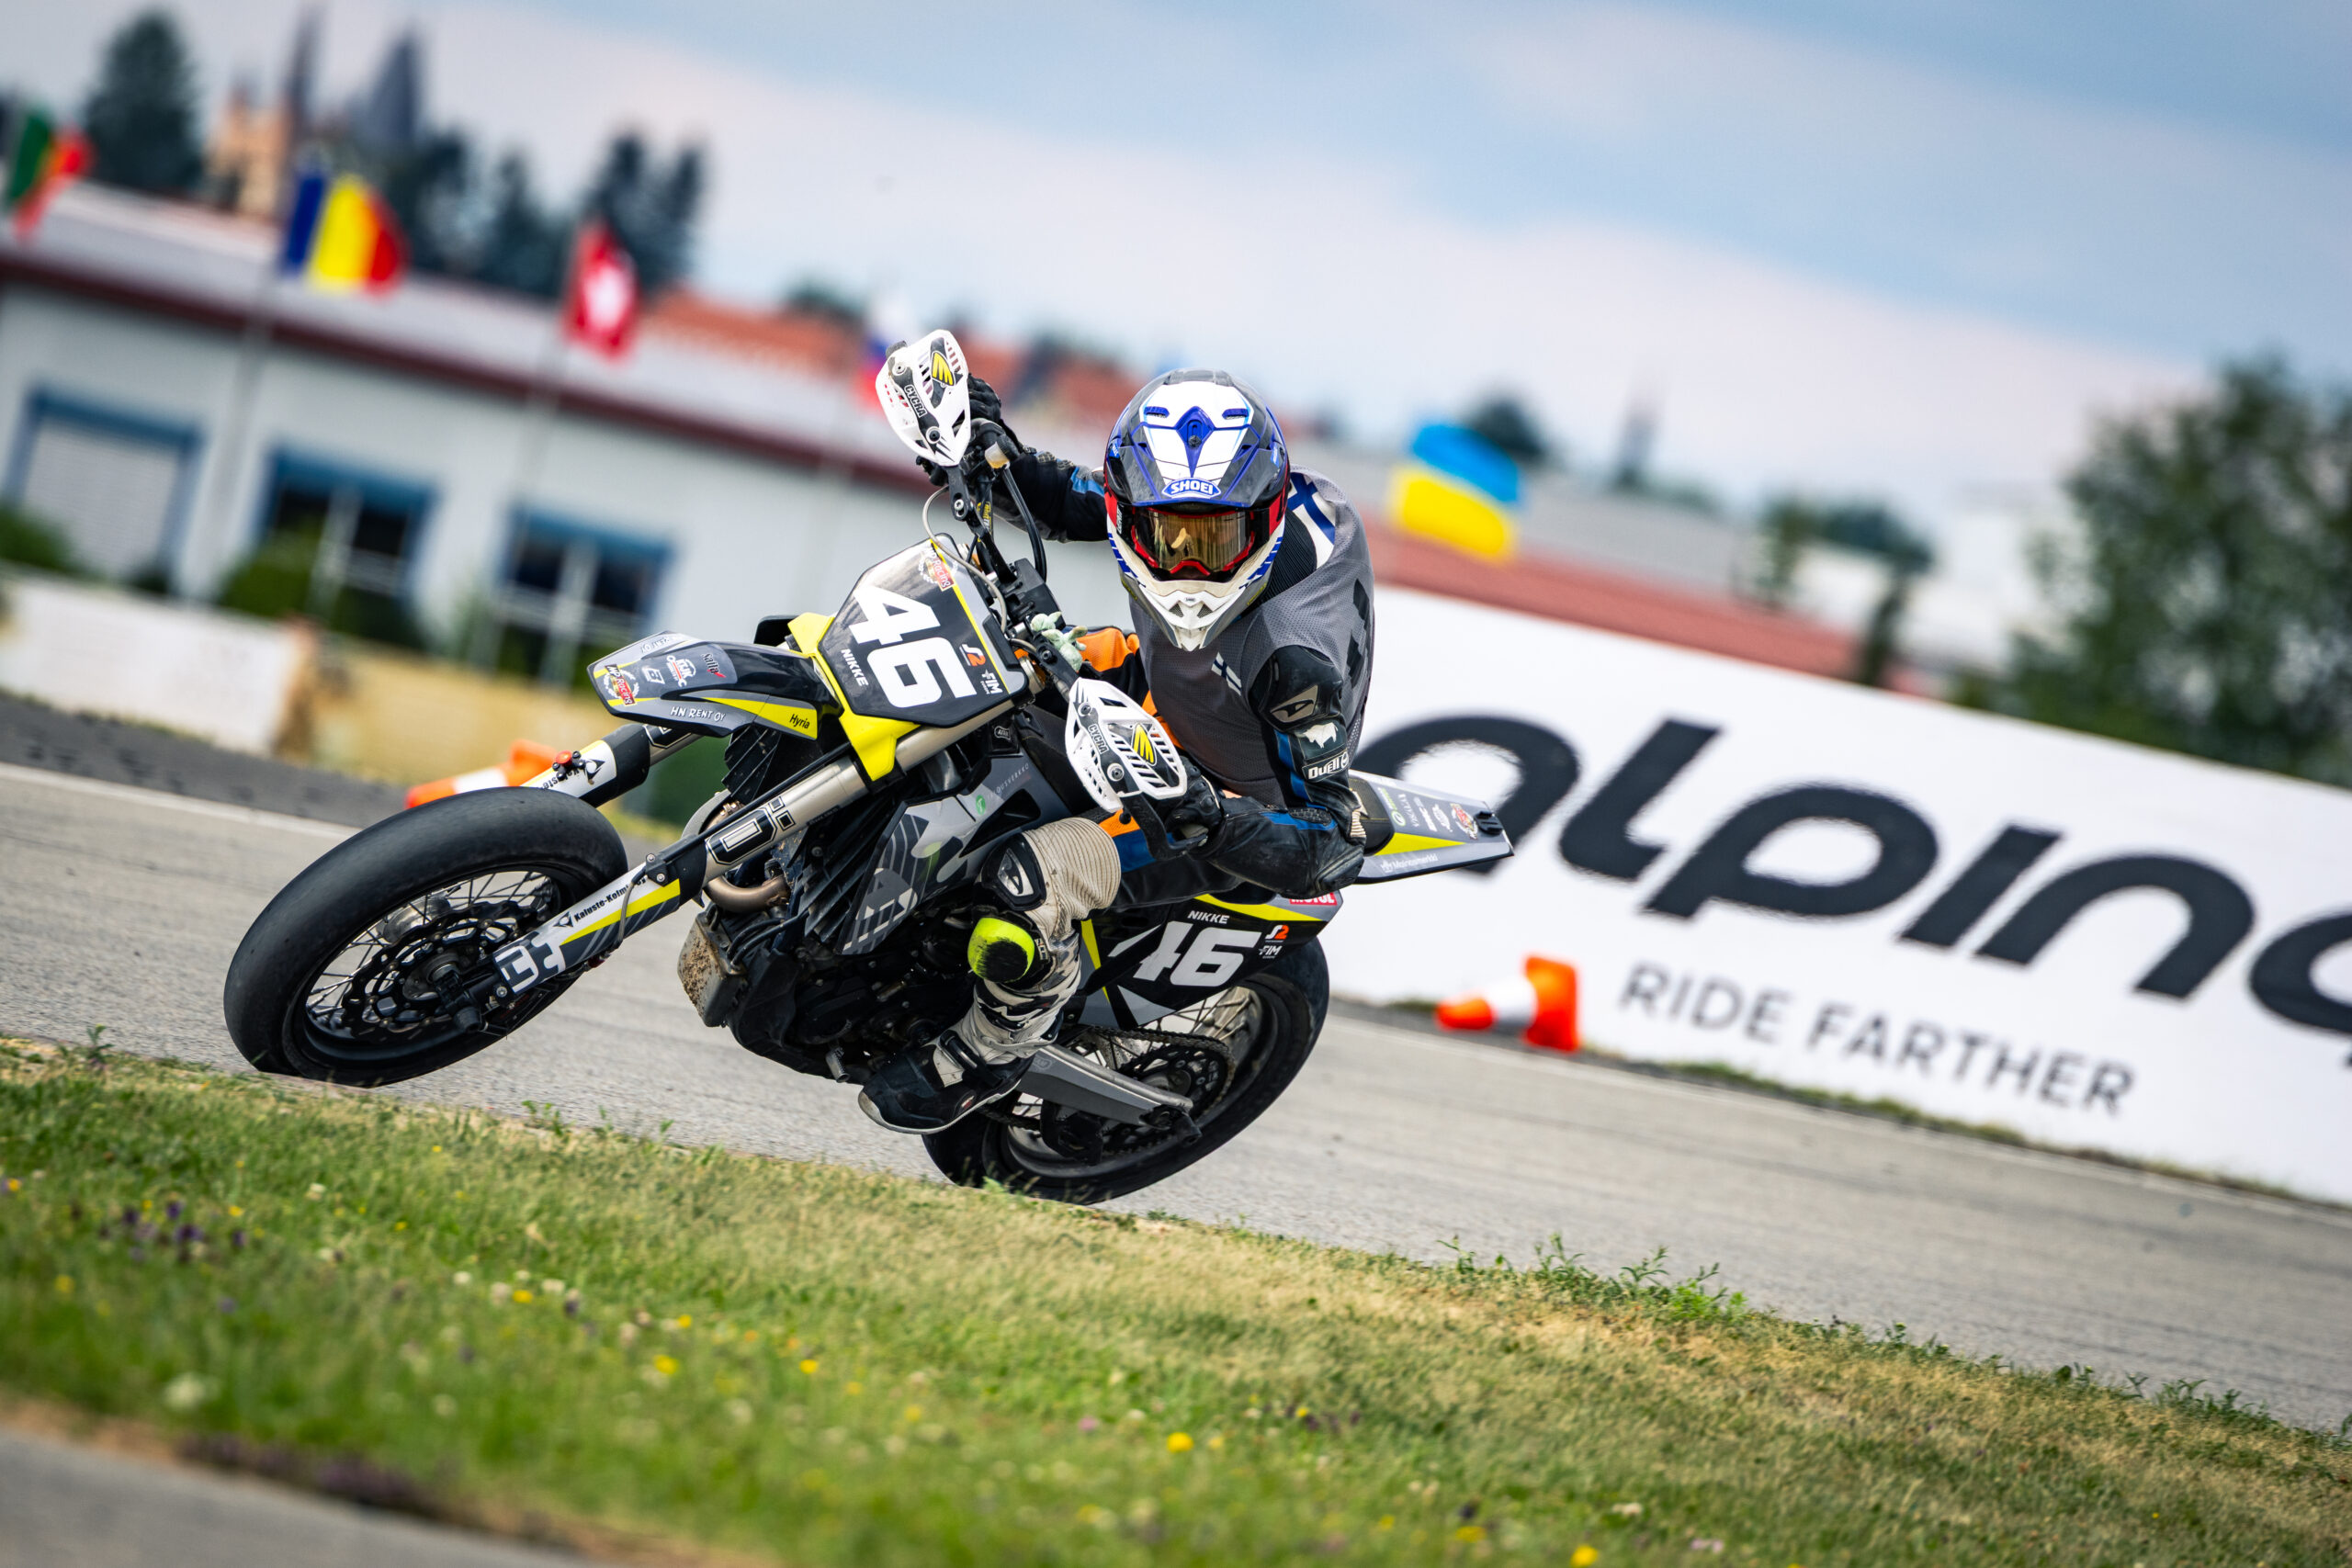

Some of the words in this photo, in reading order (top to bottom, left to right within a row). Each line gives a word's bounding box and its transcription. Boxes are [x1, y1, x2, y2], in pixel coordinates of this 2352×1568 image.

[903, 384, 927, 418] CYCRA
[1170, 479, 1214, 494] SHOEI
[848, 584, 978, 707] 46
[961, 643, 986, 667] S2
[840, 648, 870, 687] NIKKE
[605, 664, 621, 678] MP
[616, 676, 633, 705] Racing
[981, 672, 1003, 694] FIM
[670, 706, 686, 717] HN
[688, 708, 712, 719] RENT
[714, 711, 726, 722] OY
[788, 713, 811, 731] Hyria
[1087, 723, 1109, 754] CYCRA
[1291, 893, 1335, 905] TUL
[1187, 909, 1230, 925] NIKKE
[1264, 924, 1290, 940] S2
[1108, 920, 1262, 987] 46
[1259, 944, 1283, 956] FIM
[1617, 960, 1794, 1045] RIDE
[1805, 1000, 2135, 1119] FARTHER
